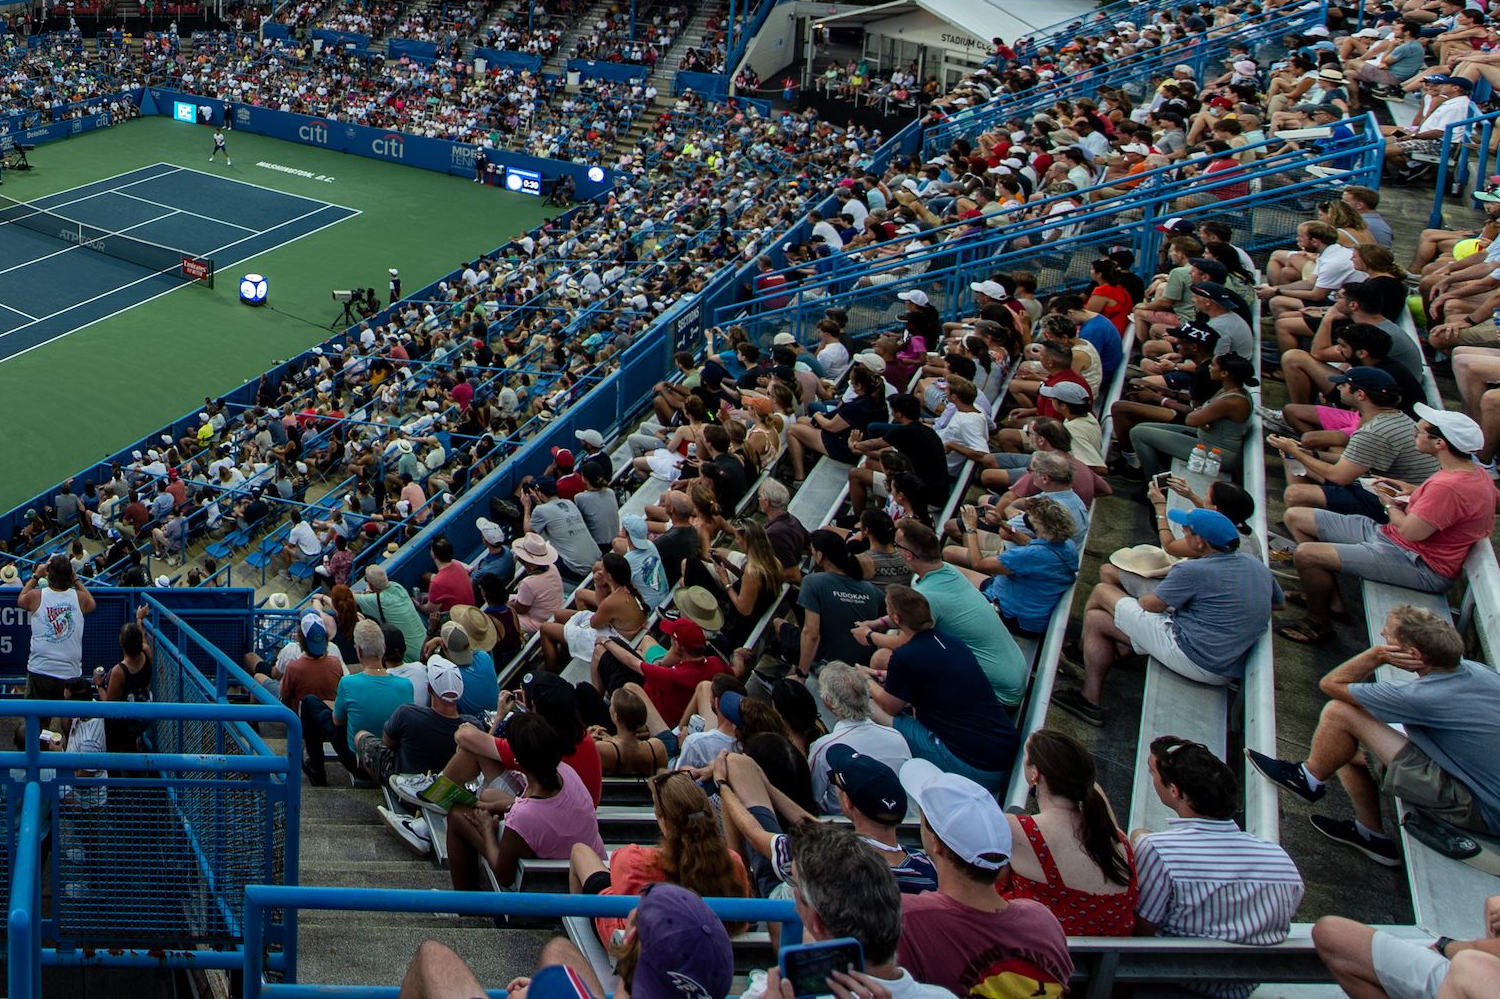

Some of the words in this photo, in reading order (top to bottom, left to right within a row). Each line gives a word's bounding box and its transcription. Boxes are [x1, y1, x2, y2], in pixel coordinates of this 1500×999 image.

[941, 33, 975, 48] STADIUM
[976, 41, 995, 51] CLU
[299, 120, 328, 144] citi
[372, 133, 404, 159] citi
[450, 154, 476, 167] TENN
[183, 260, 206, 272] Emirates
[677, 306, 700, 333] SECTIONS
[832, 590, 870, 600] FUDOKAN
[0, 636, 13, 654] 5
